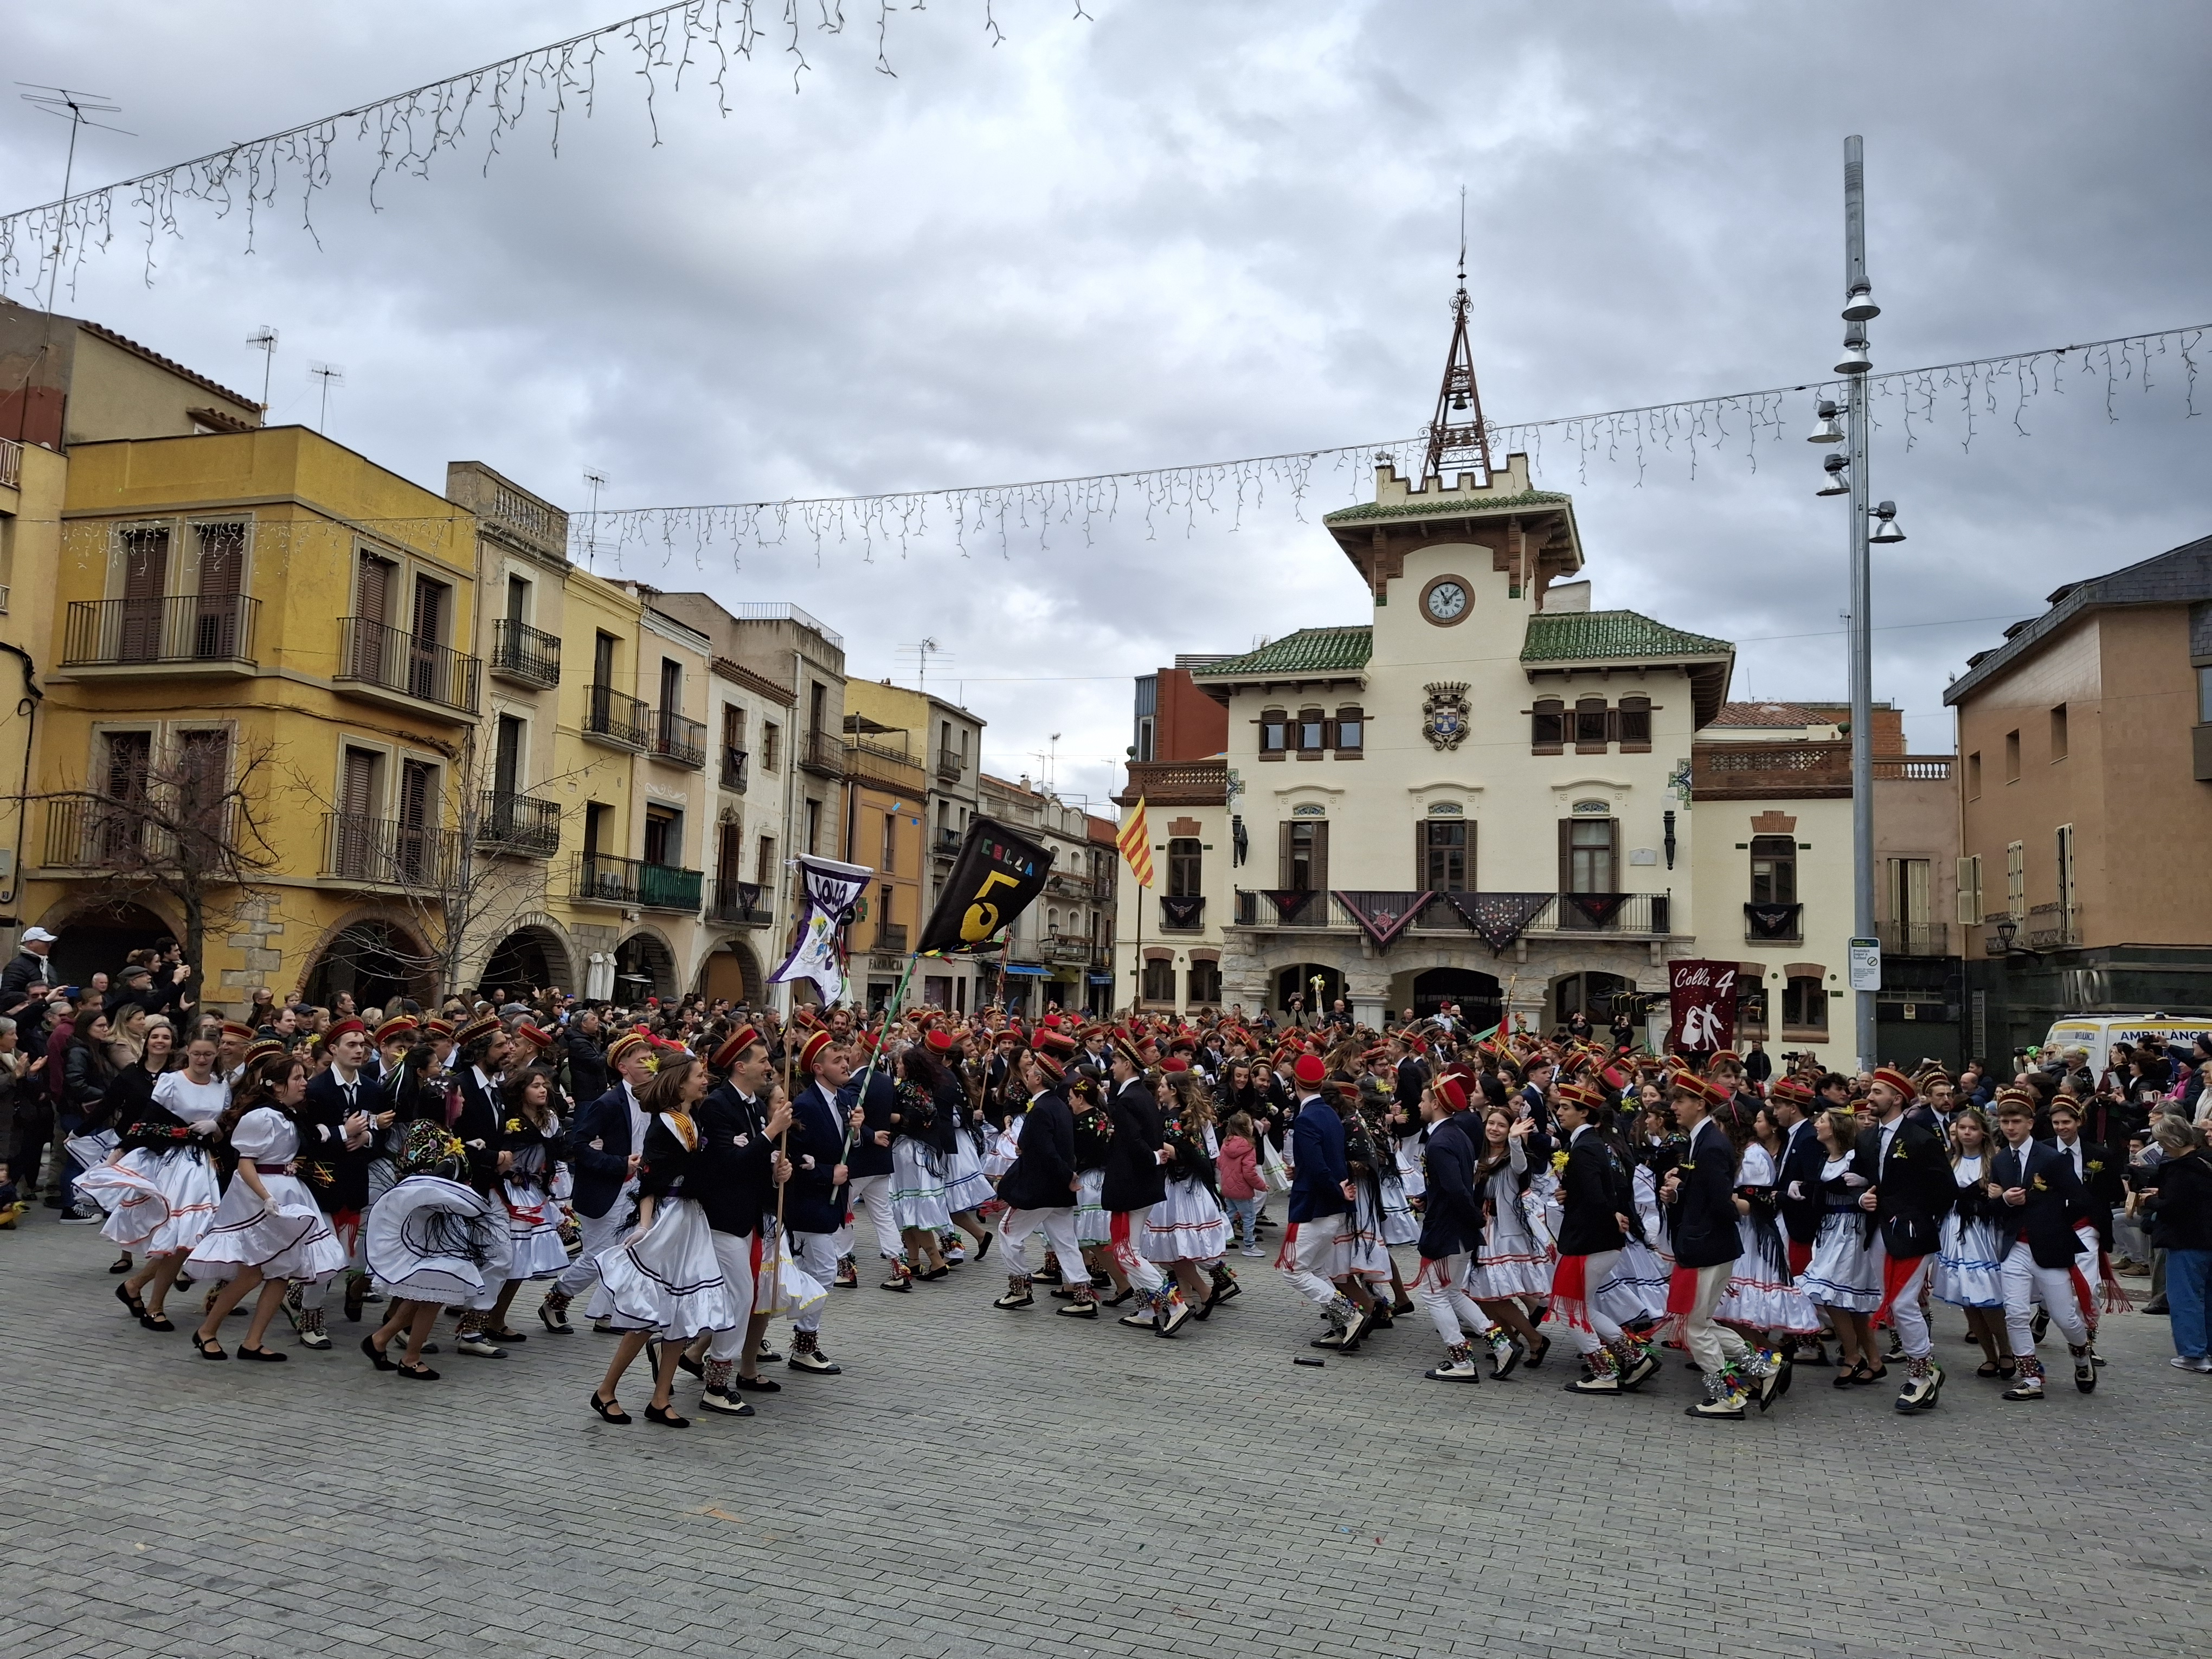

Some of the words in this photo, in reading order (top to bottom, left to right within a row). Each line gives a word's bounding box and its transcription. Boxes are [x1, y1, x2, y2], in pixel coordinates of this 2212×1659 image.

[981, 838, 1033, 877] COLLA
[1674, 967, 1711, 988] Colla
[1715, 969, 1735, 998] 4
